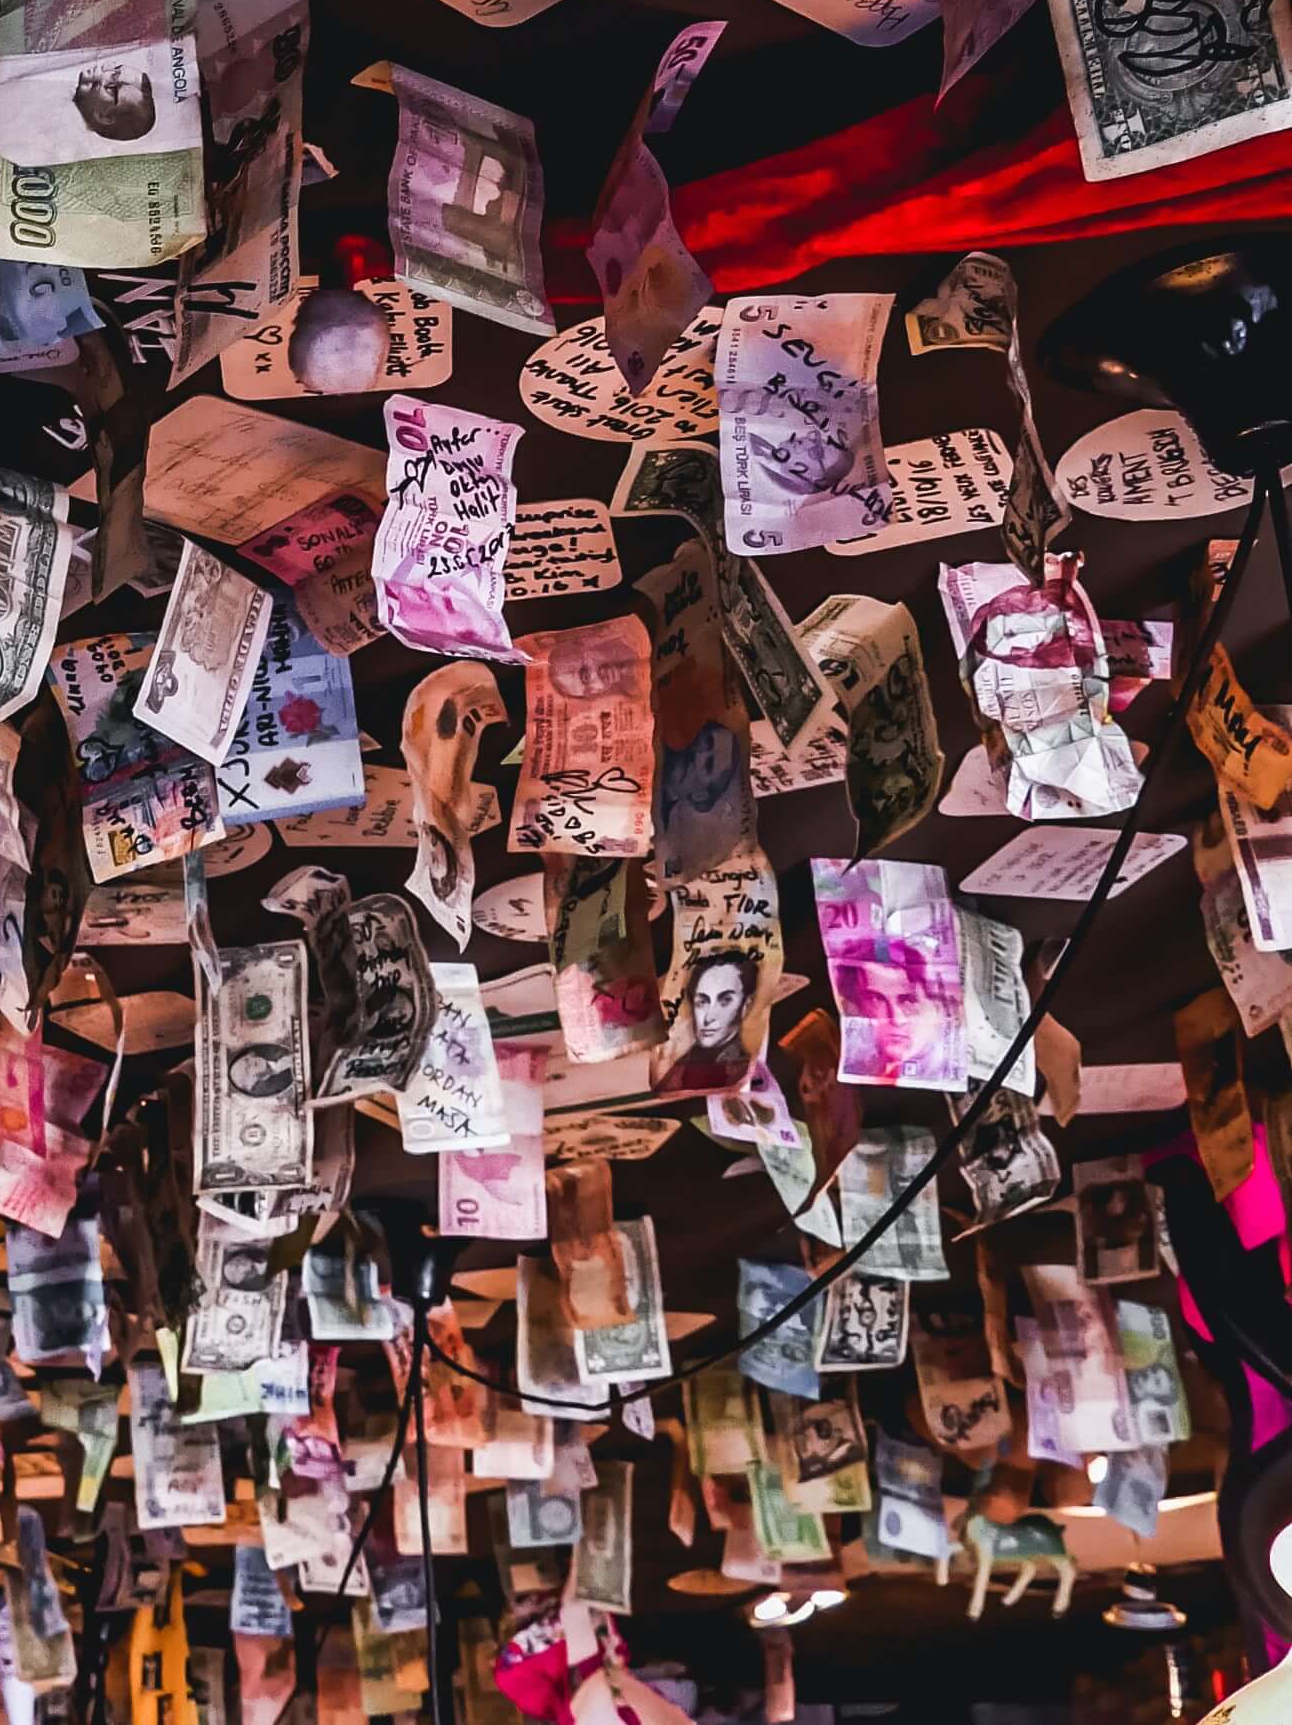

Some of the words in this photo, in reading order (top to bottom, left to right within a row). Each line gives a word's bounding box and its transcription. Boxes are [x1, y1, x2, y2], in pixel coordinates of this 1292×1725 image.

[172, 47, 189, 104] ANGOLA
[740, 306, 779, 323] 5
[393, 407, 429, 452] 10
[908, 460, 951, 525] 18/10/16
[742, 528, 783, 548] 5
[827, 902, 858, 929] 20
[458, 1199, 479, 1226] 10
